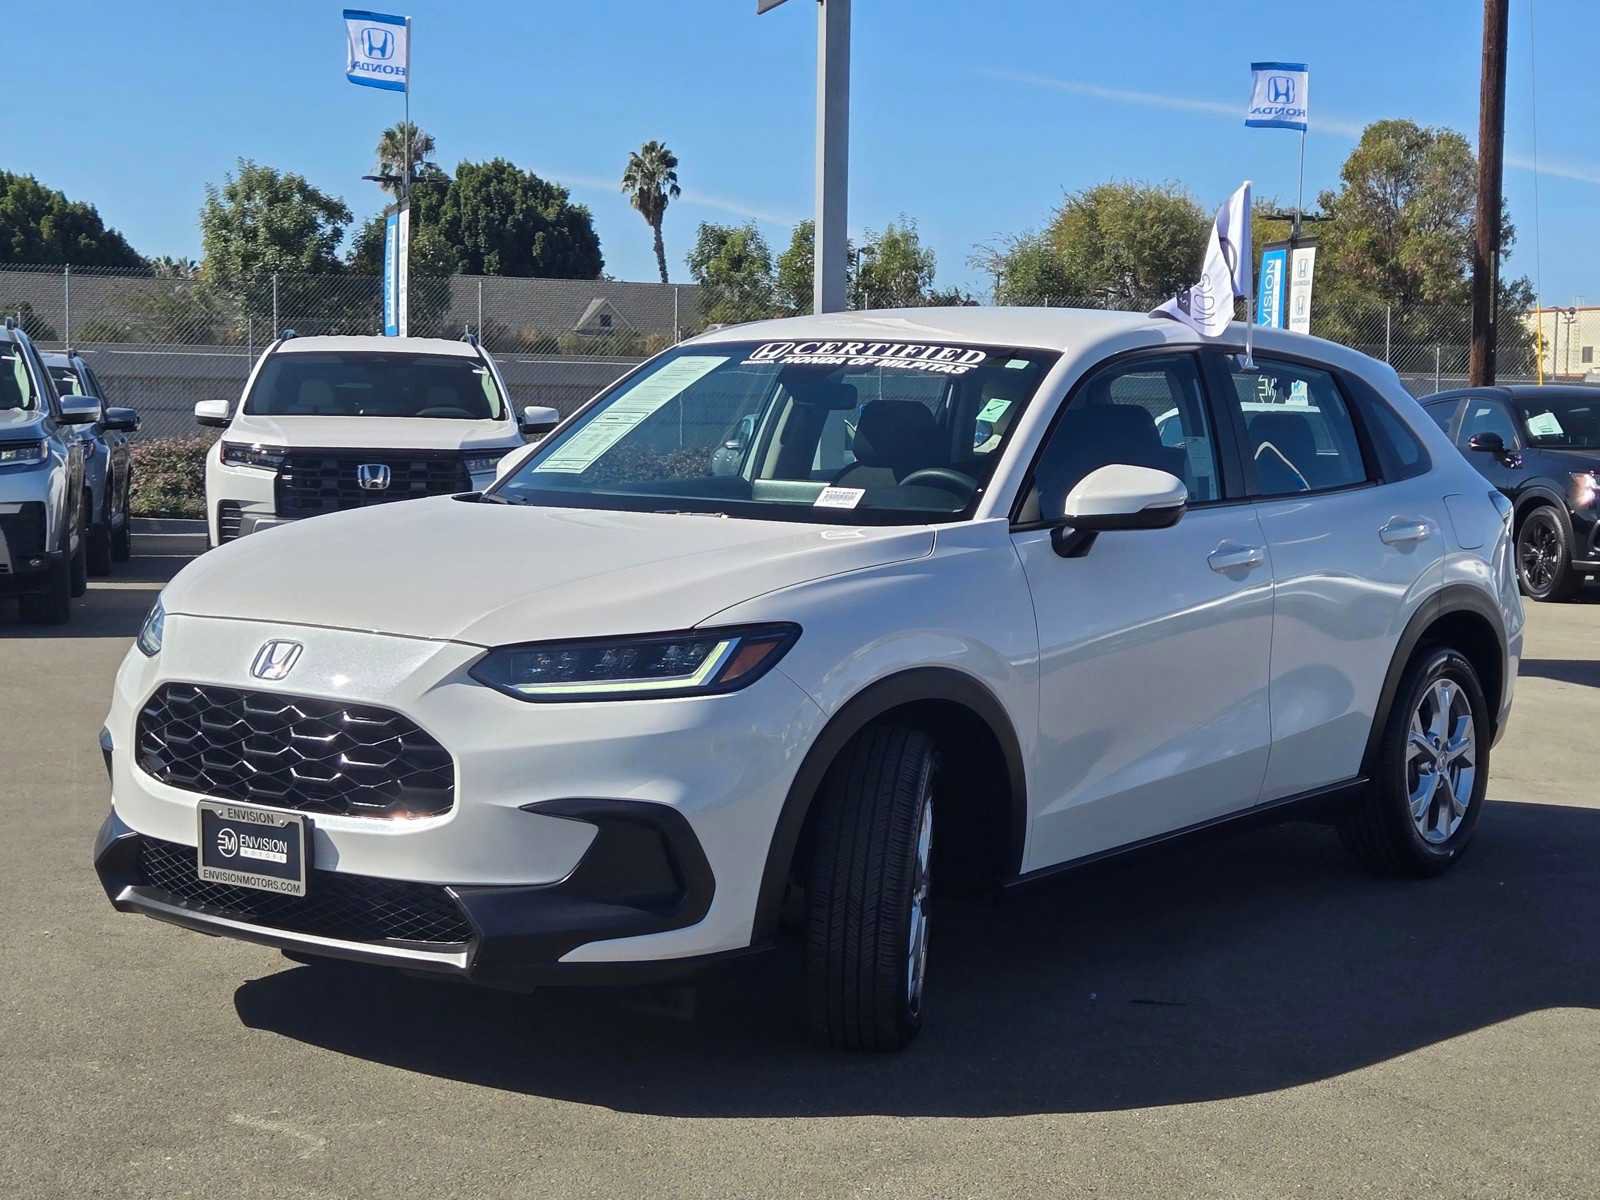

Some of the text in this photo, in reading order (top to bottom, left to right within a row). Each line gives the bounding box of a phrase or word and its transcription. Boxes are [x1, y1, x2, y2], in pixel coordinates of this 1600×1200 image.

[794, 342, 986, 364] CERTIFIED
[779, 356, 847, 365] HONDA
[848, 357, 875, 366] OF
[876, 358, 970, 374] MILPITAS
[228, 808, 274, 824] ENVISION
[240, 834, 287, 853] ENVISION
[203, 869, 300, 893] ENVISIONMOTORS.COM
